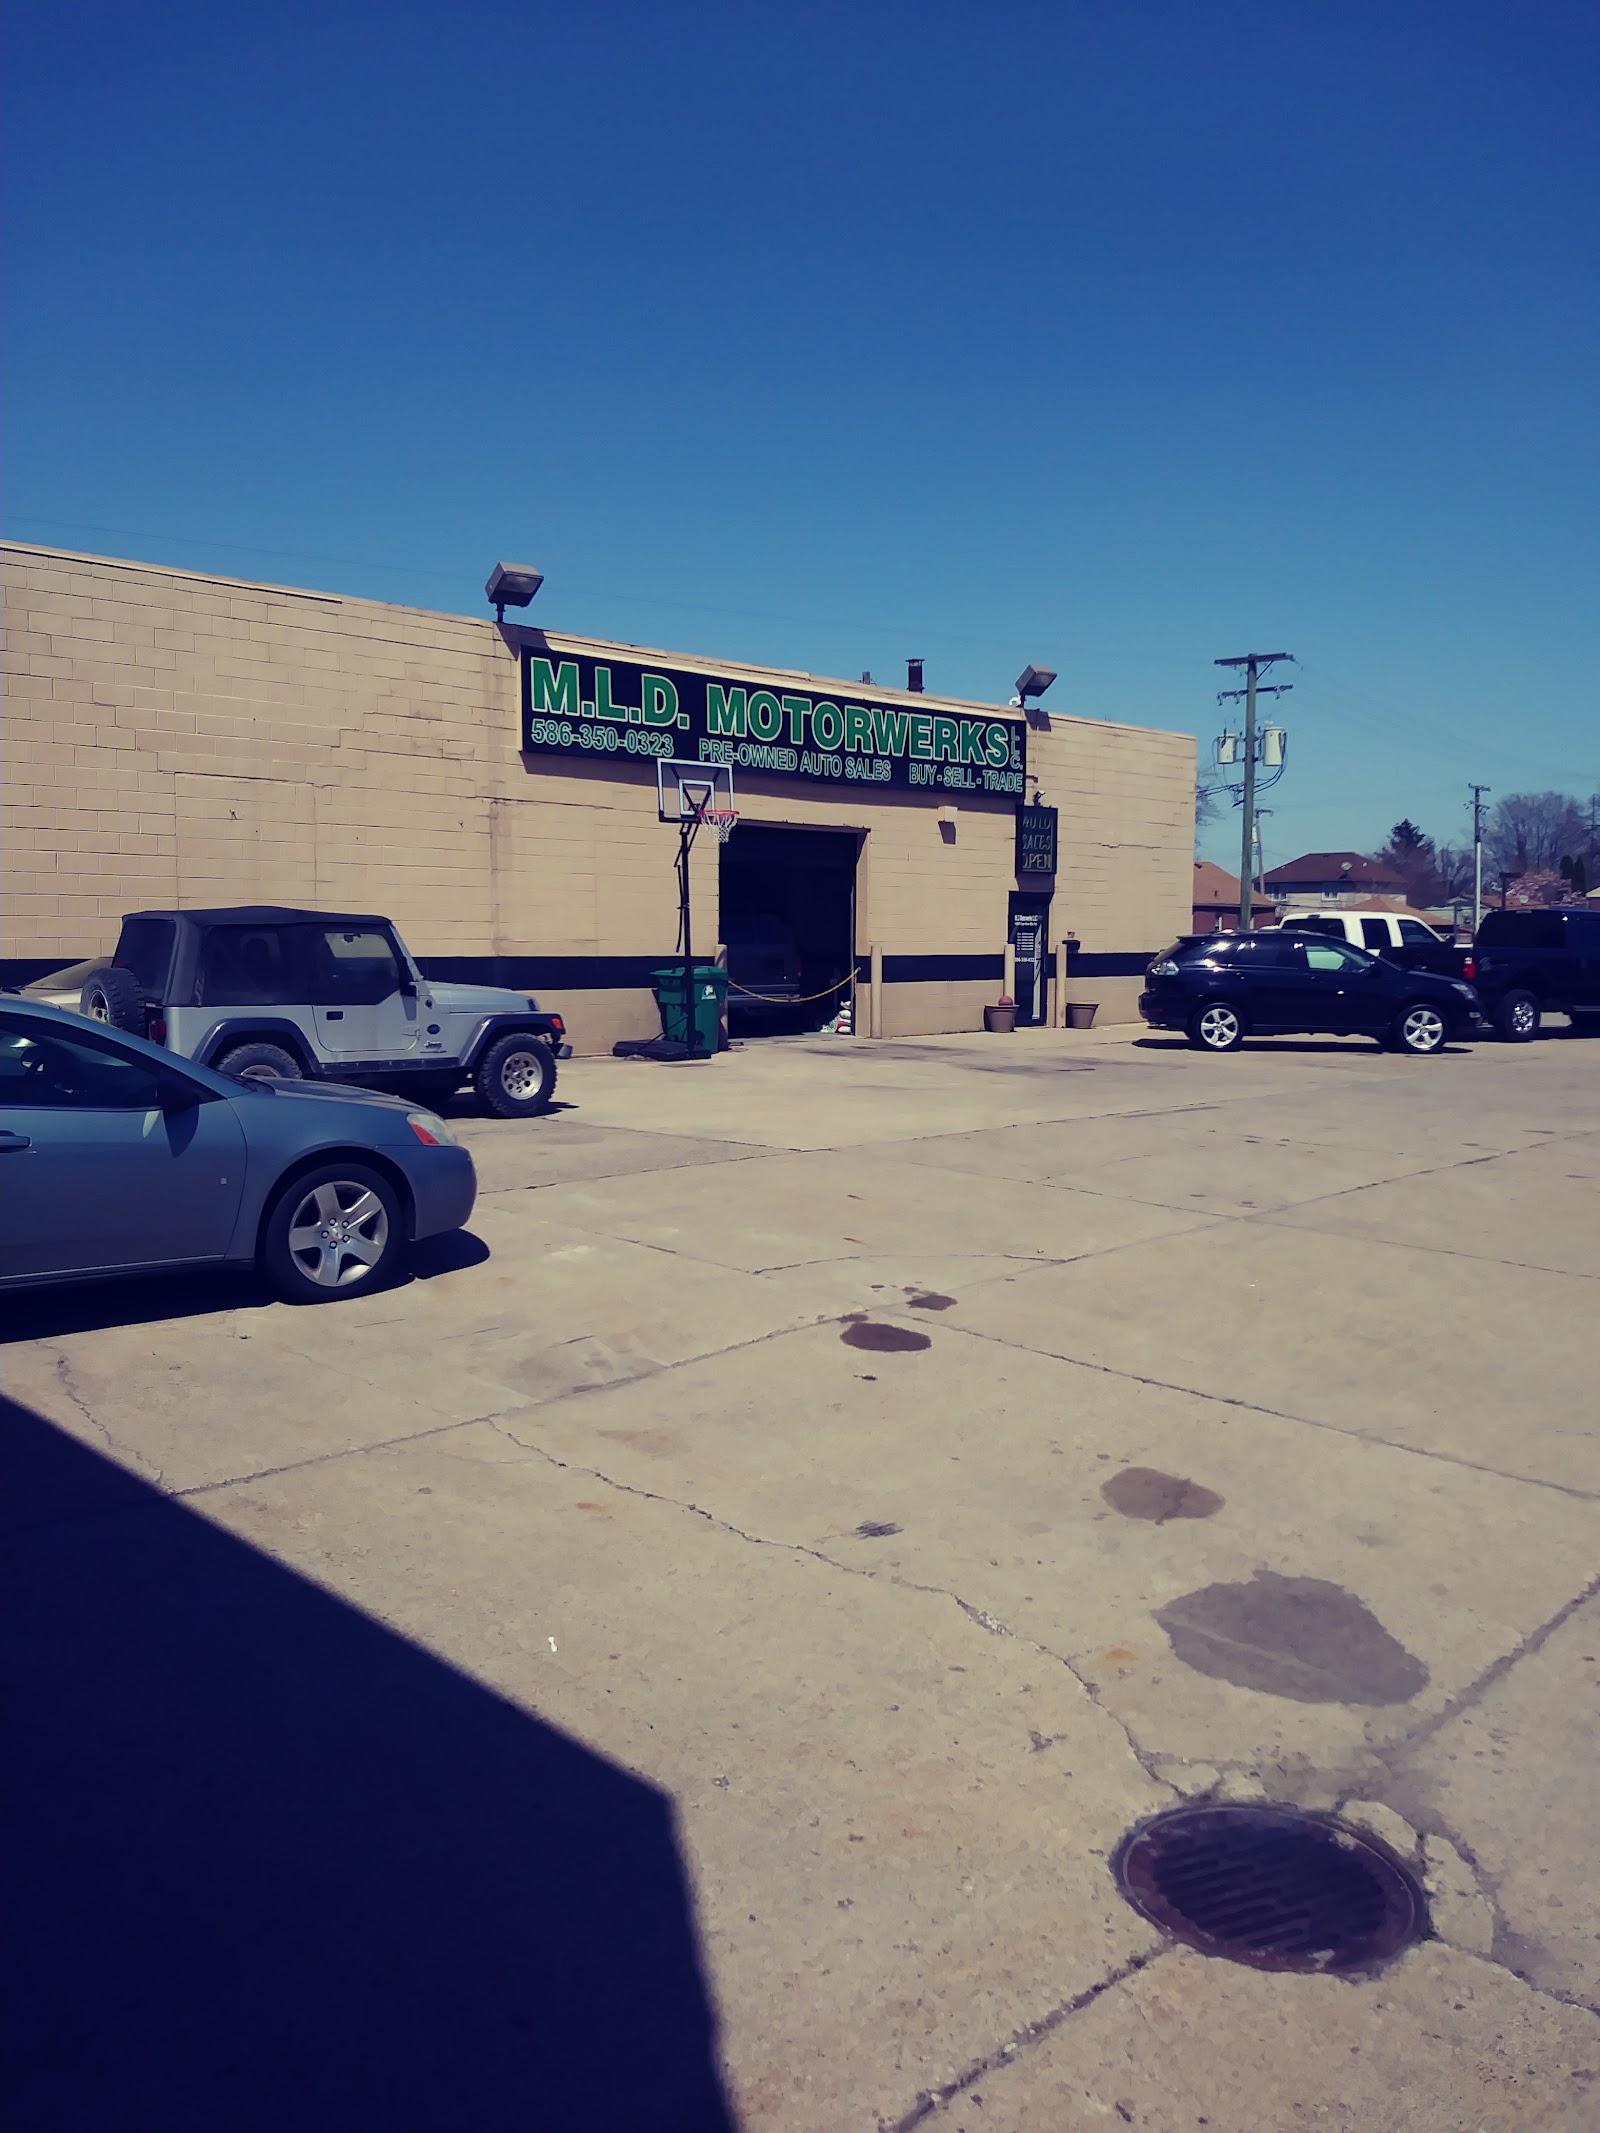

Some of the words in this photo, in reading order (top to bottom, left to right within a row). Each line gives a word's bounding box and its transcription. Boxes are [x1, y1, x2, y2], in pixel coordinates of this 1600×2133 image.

[530, 656, 690, 731] M.L.D.
[706, 683, 1010, 769] MOTORWERKS
[531, 718, 675, 758] 586-350-0323
[699, 737, 798, 772] PRE-OWNED
[800, 750, 843, 778] AUTO
[845, 756, 892, 782] SALES
